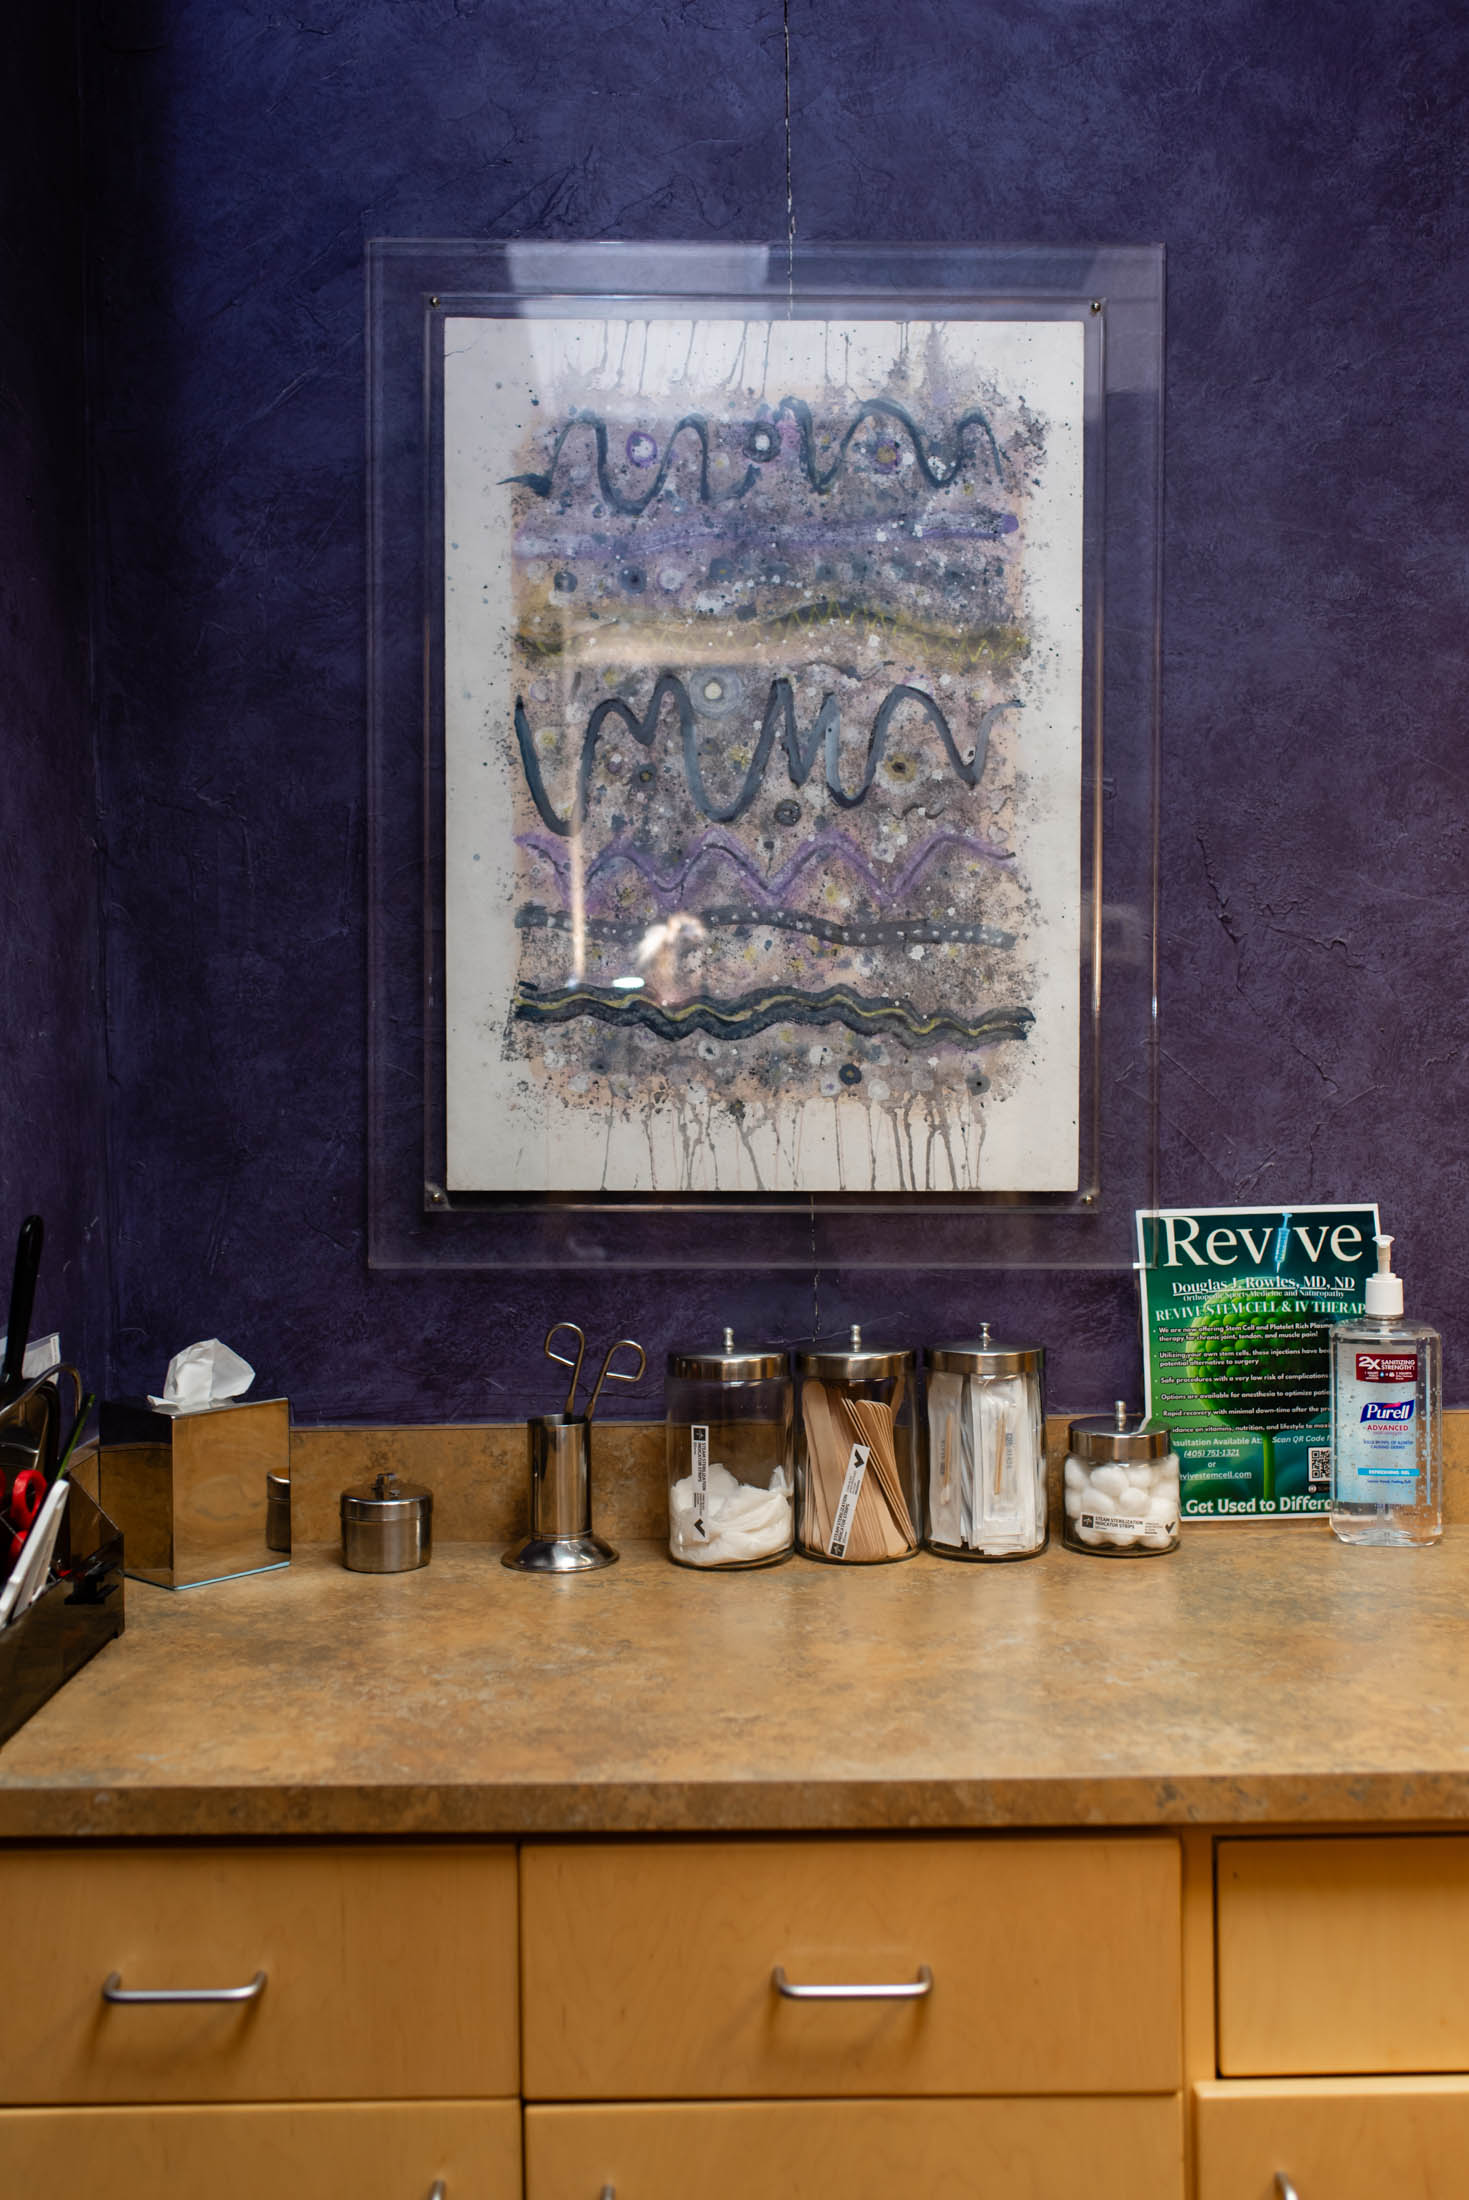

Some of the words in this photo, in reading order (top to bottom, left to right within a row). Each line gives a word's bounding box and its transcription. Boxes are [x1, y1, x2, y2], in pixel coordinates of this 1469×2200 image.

[1159, 1213, 1363, 1271] Revive
[1172, 1278, 1228, 1296] Douglas
[1246, 1276, 1300, 1289] Rowles,
[1304, 1276, 1330, 1289] MD,
[1334, 1276, 1355, 1289] ND
[1300, 1290, 1344, 1298] Naturopathy
[1155, 1305, 1202, 1321] REVIVE
[1206, 1302, 1242, 1316] STEM
[1245, 1301, 1276, 1313] CELL
[1282, 1300, 1292, 1312] &
[1295, 1300, 1309, 1312] IV
[1312, 1301, 1366, 1314] THERAP
[1302, 1330, 1318, 1338] pain!
[1270, 1348, 1300, 1356] injections
[1358, 1356, 1381, 1370] 2X
[1176, 1376, 1212, 1384] procedures
[1285, 1372, 1328, 1380] complications
[1242, 1390, 1276, 1398] anesthesia
[1366, 1404, 1410, 1419] Purell
[1280, 1422, 1304, 1430] lifestyle
[1368, 1424, 1408, 1432] ADVANCED
[1213, 1437, 1250, 1446] Available
[1292, 1436, 1304, 1444] QR
[1306, 1434, 1326, 1442] Code
[1184, 1450, 1205, 1458] (405)
[1207, 1449, 1240, 1458] 751-1321
[1180, 1471, 1252, 1480] evivestemcell.com
[1186, 1499, 1214, 1514] Get
[1218, 1498, 1256, 1513] Used
[1260, 1498, 1276, 1512] to
[1280, 1496, 1334, 1512] Differe
